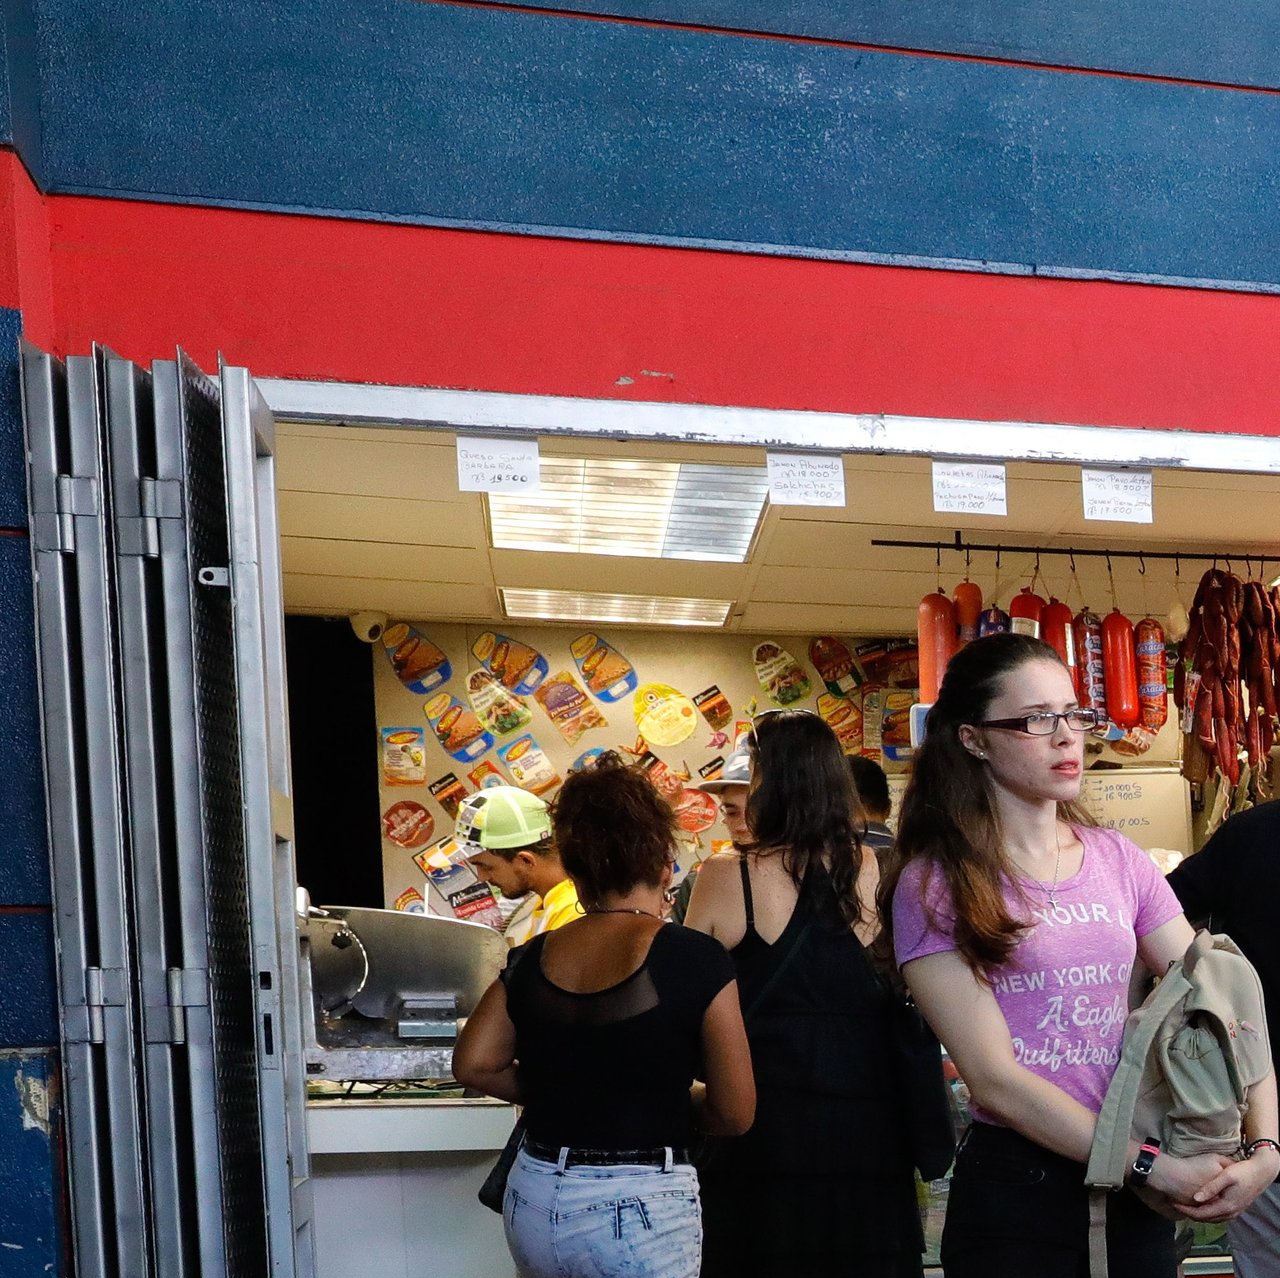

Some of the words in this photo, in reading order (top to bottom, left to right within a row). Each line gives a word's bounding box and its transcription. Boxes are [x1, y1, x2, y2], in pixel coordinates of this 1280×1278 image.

[1031, 902, 1112, 928] YOUR
[994, 970, 1045, 994] NEW
[1053, 964, 1112, 988] YORK
[1013, 1036, 1120, 1072] Outfitters
